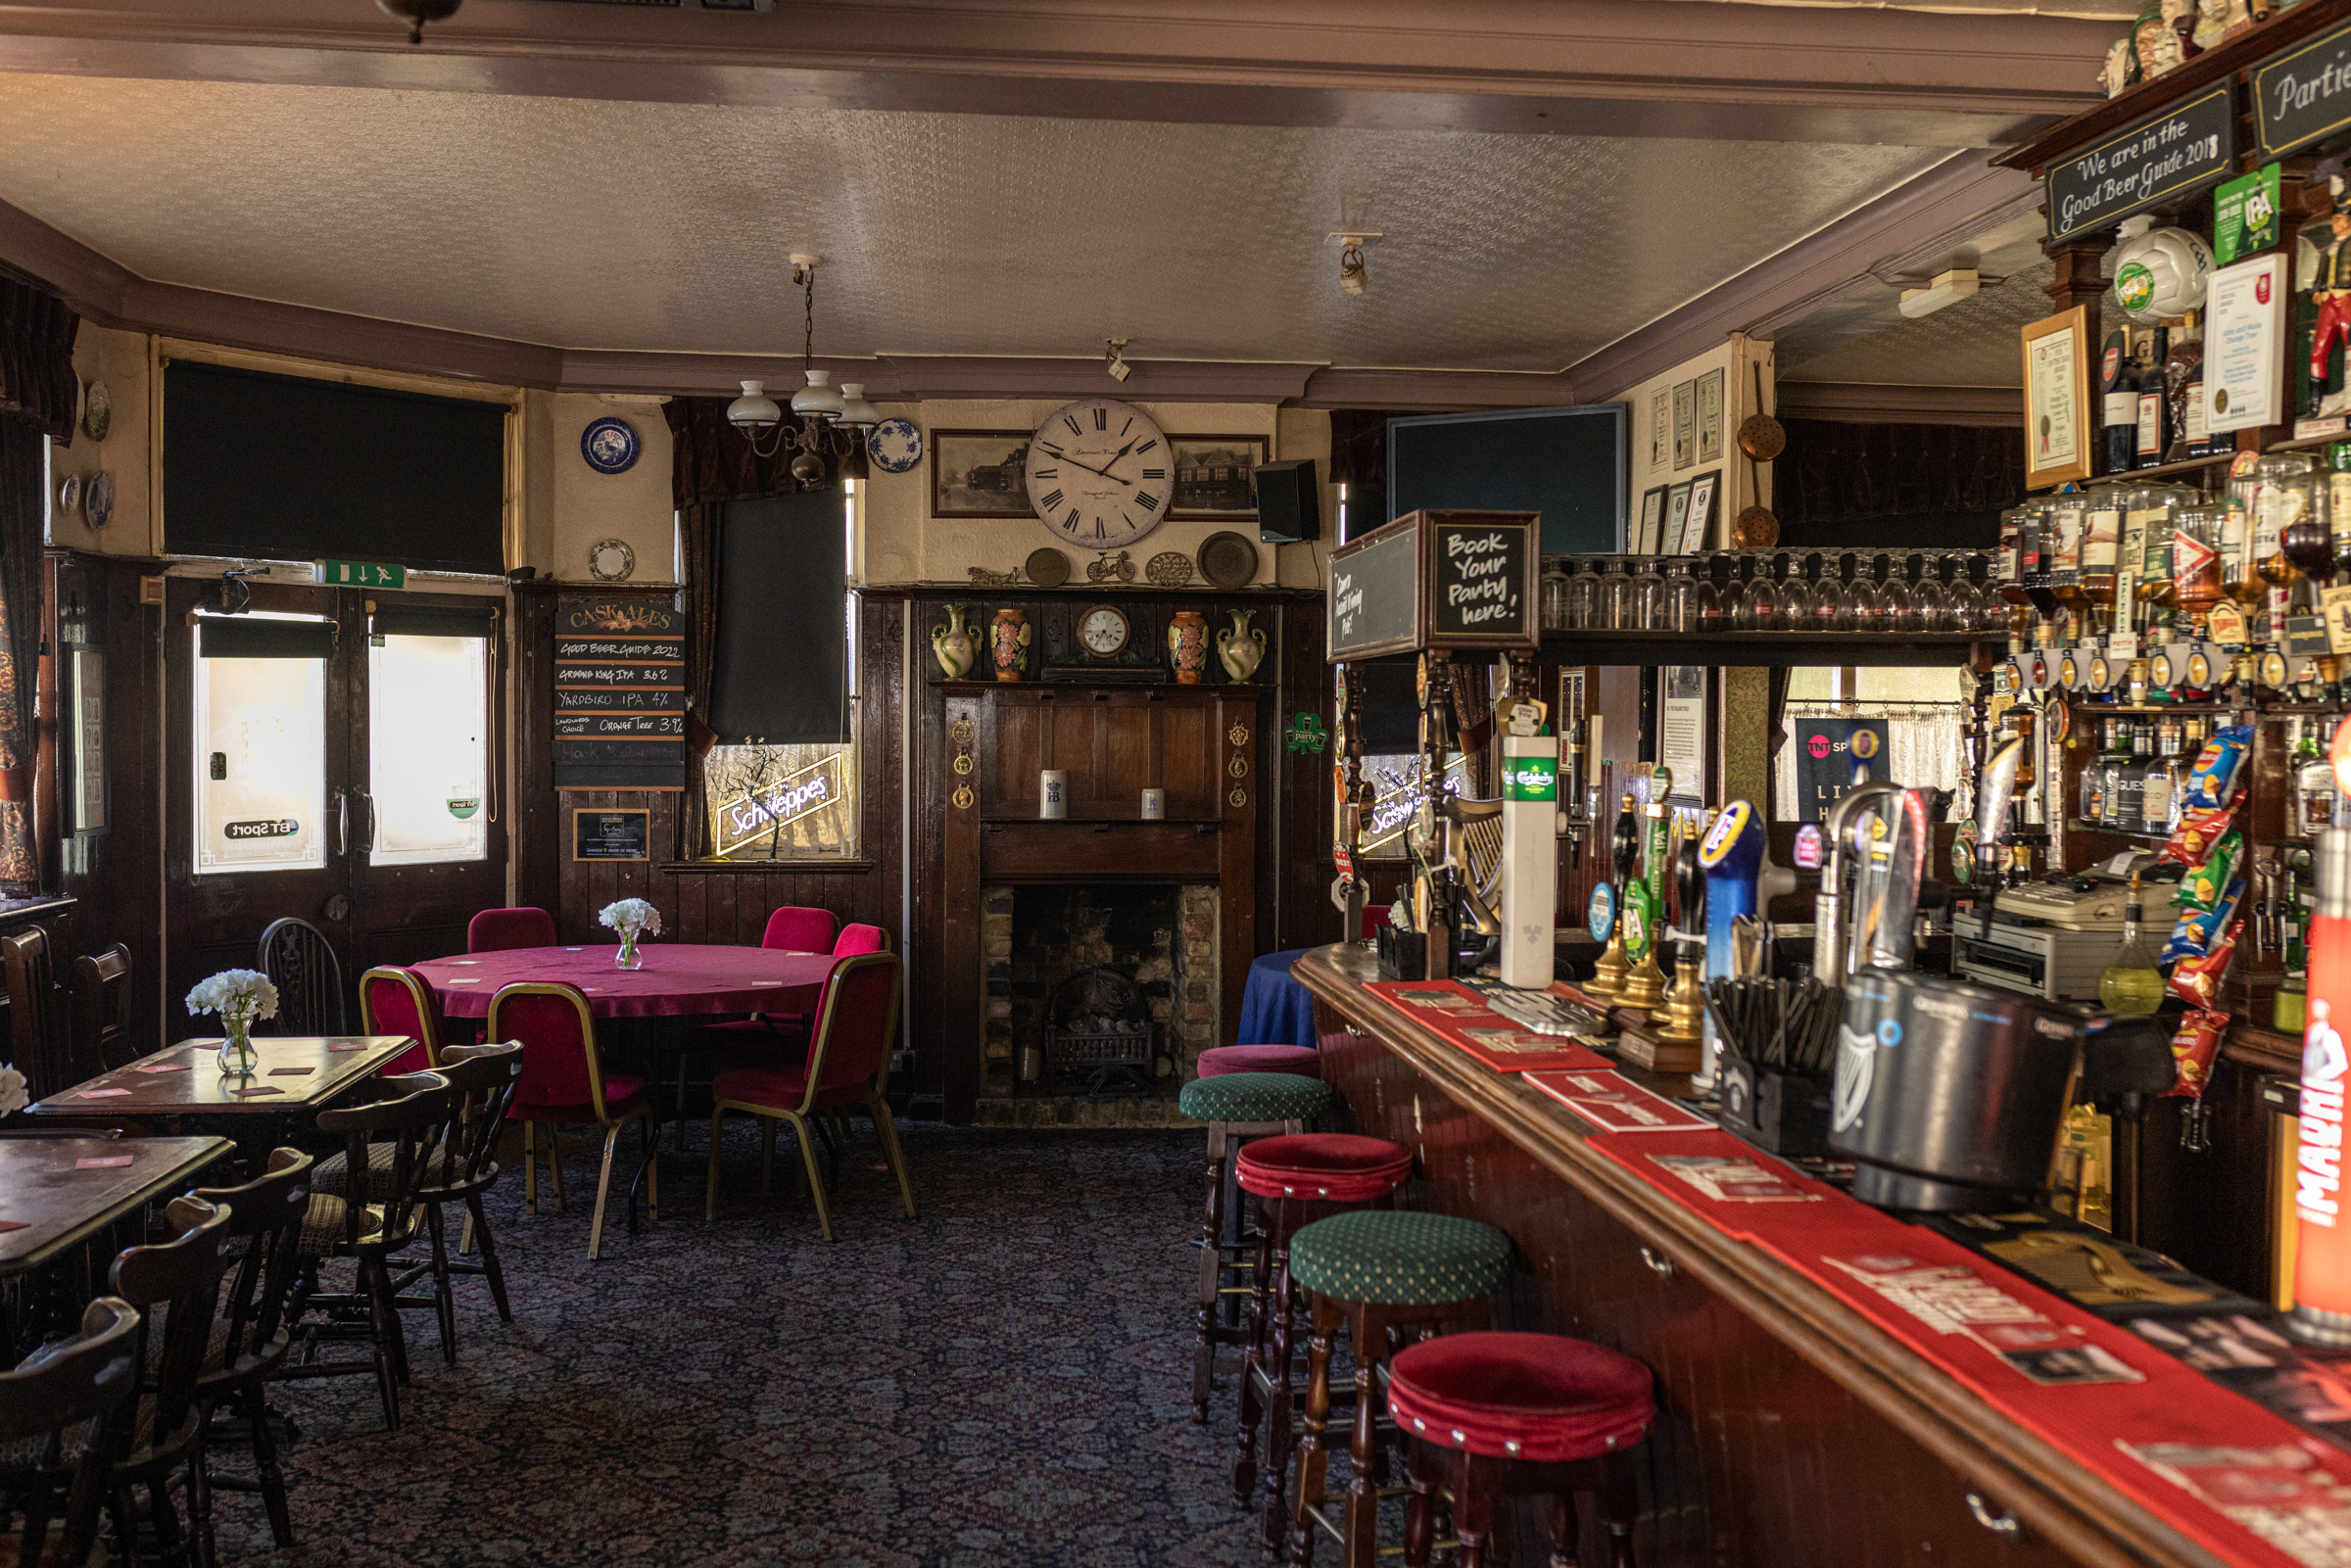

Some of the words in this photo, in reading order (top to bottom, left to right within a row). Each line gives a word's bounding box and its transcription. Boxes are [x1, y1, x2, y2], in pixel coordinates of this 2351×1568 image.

[2076, 153, 2106, 181] We
[2111, 142, 2138, 169] are
[2141, 130, 2158, 152] in
[2160, 119, 2188, 146] the
[2059, 180, 2101, 233] Good
[2102, 173, 2139, 203] Beer
[2136, 148, 2184, 200] Guide
[2184, 134, 2220, 170] 2018
[1448, 533, 1509, 557] Book
[1455, 555, 1507, 580] Your
[1449, 576, 1507, 606] Party
[570, 604, 618, 628] CASK
[623, 604, 672, 629] ALES
[1462, 594, 1517, 626] here!
[560, 642, 588, 657] GOOD
[590, 643, 620, 655] BEER
[617, 644, 651, 659] GUIDE
[651, 644, 681, 658] 2022
[558, 669, 594, 681] GREENE
[595, 669, 615, 685] KING
[615, 669, 635, 681] IPA
[651, 691, 668, 706] 4%
[562, 724, 585, 734] CHOICE
[600, 719, 632, 733] ORANGE
[629, 716, 654, 731] TREE
[1295, 733, 1317, 742] party
[1808, 742, 1831, 752] TNT
[1516, 770, 1555, 786] Carlsberg
[1047, 792, 1060, 802] HB
[731, 776, 827, 836] Schweppes
[1655, 830, 1667, 849] IPA
[1335, 858, 1351, 868] BEST
